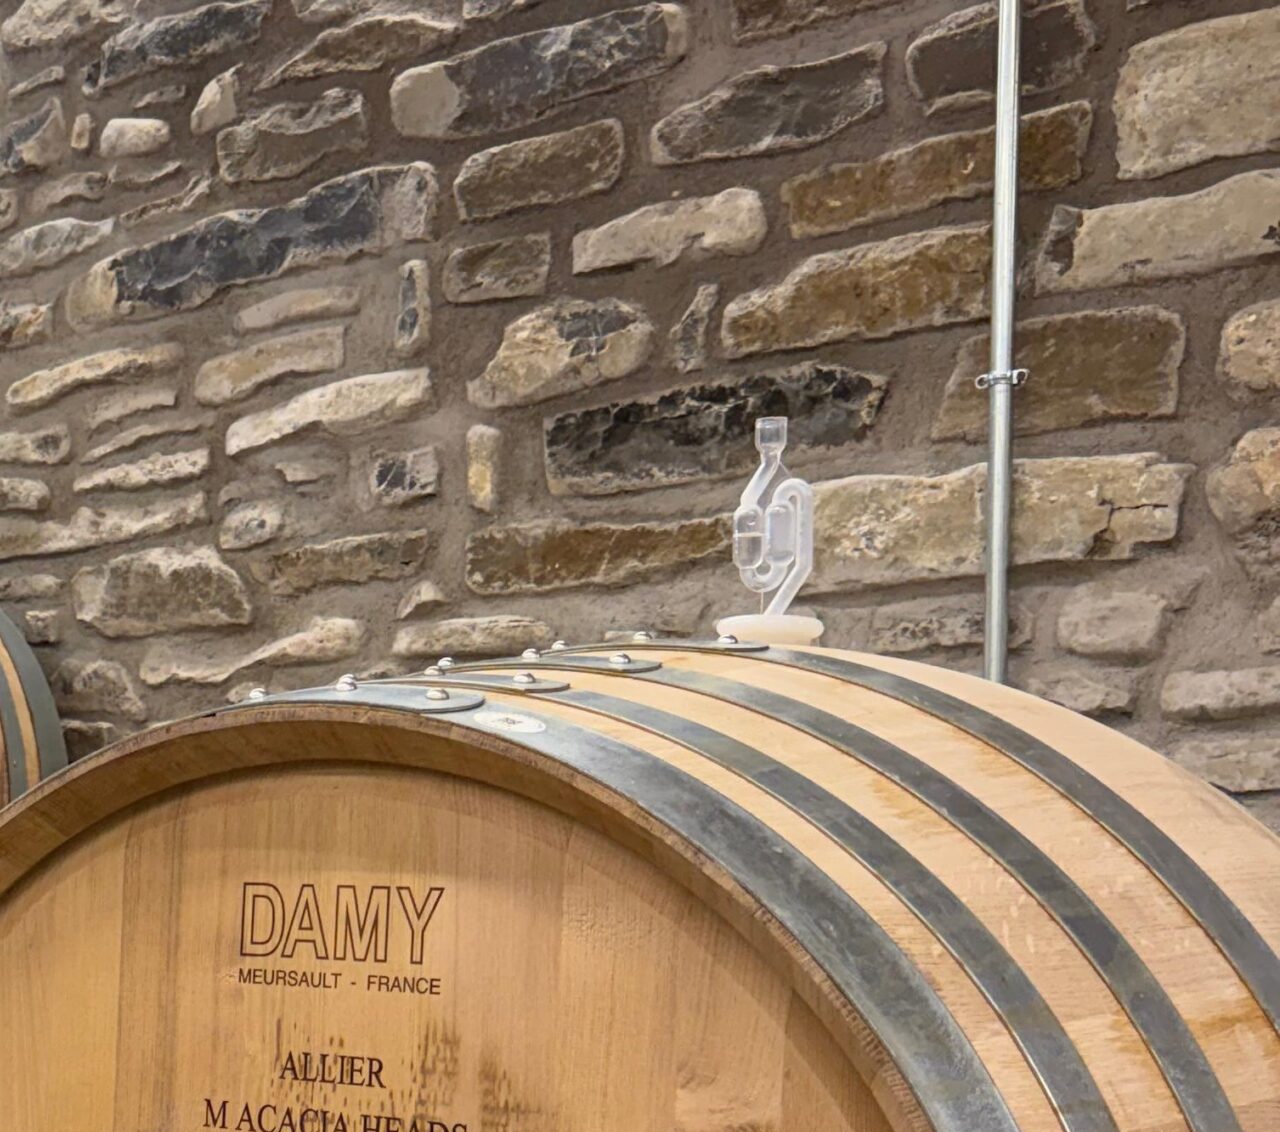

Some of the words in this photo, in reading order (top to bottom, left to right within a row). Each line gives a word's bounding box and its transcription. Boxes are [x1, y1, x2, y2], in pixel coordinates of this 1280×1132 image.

[239, 881, 445, 965] DAMY
[238, 968, 342, 989] MEURSAULT
[366, 975, 441, 995] FRANCE
[279, 1050, 386, 1088] ALLIER
[203, 1098, 229, 1129] M
